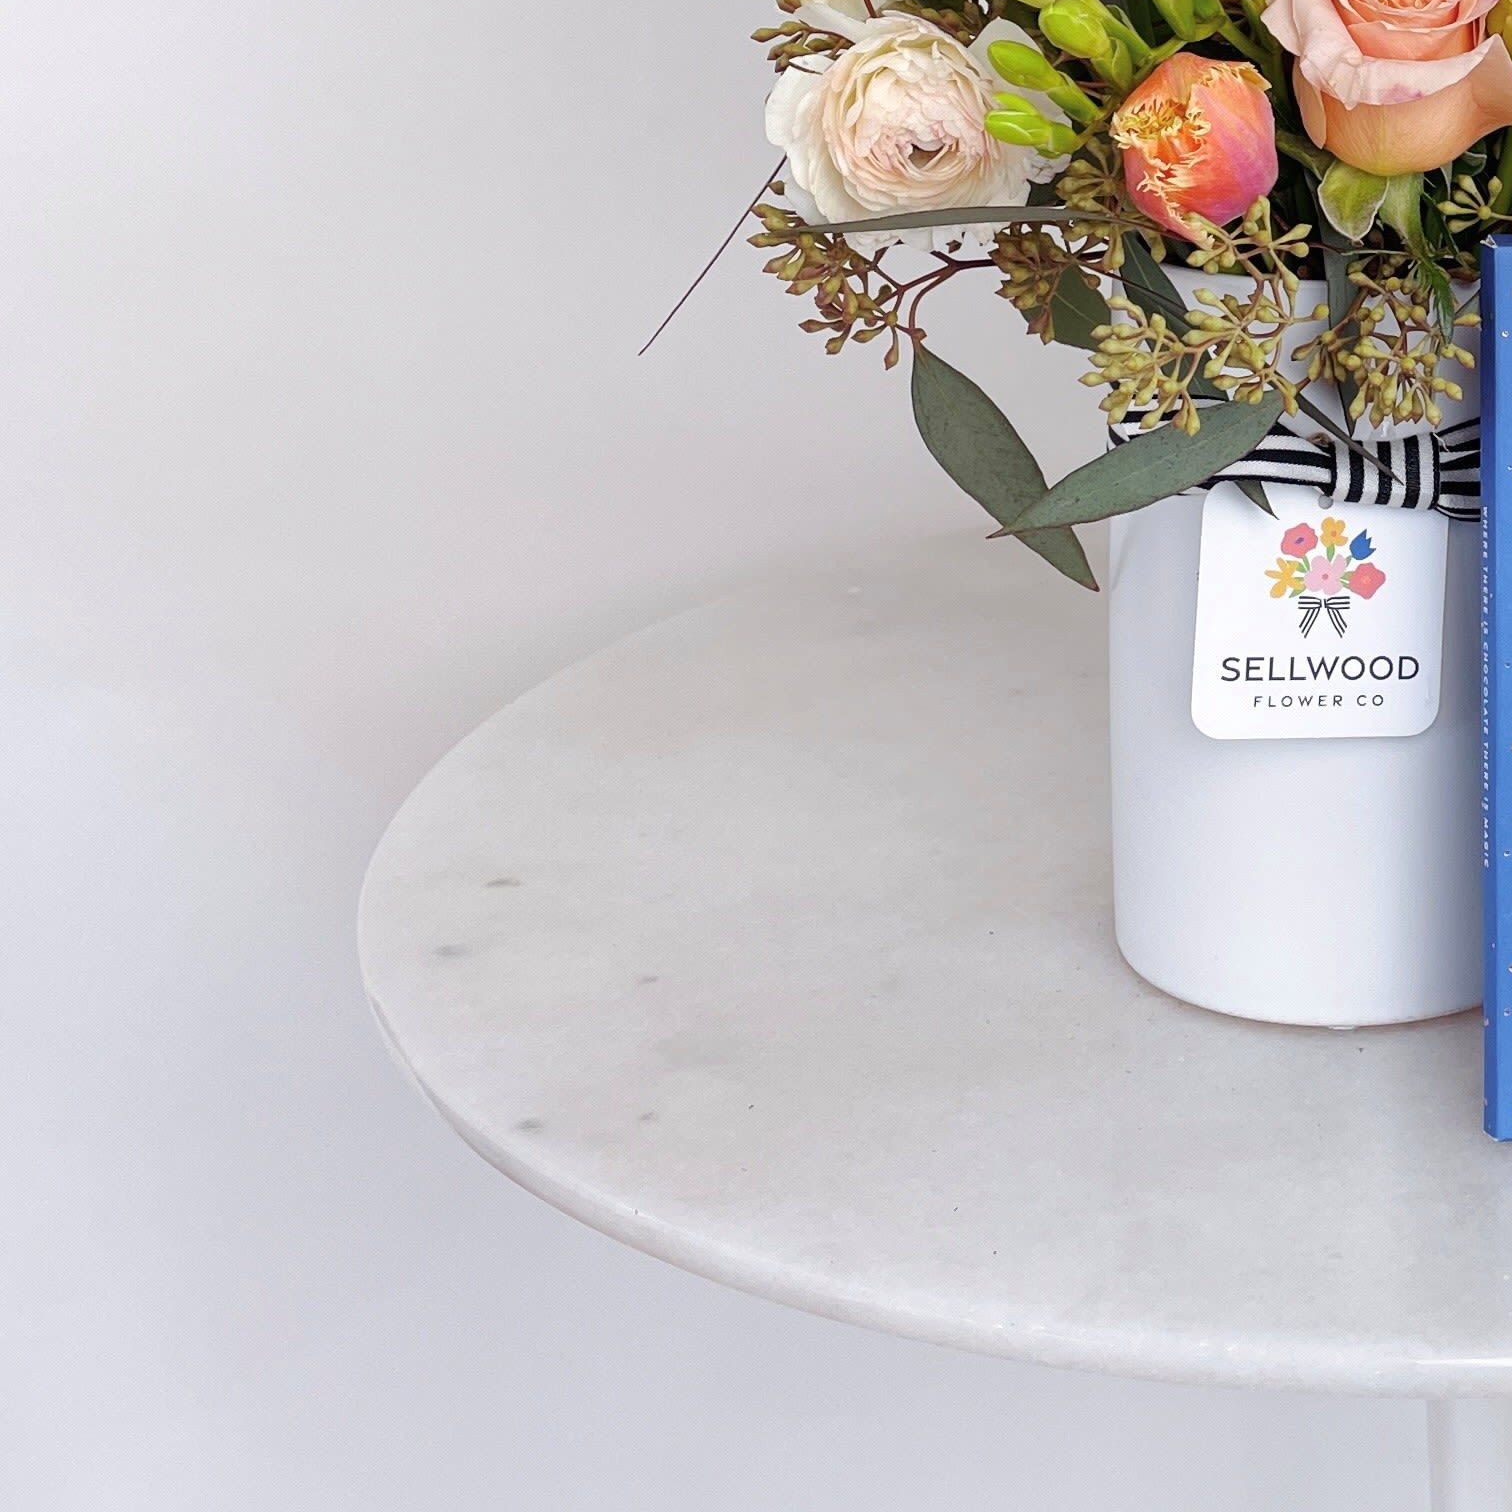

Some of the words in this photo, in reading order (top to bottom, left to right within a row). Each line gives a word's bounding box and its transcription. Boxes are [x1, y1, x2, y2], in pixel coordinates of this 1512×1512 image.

[1220, 655, 1420, 682] SELLWOOD
[1253, 695, 1343, 708] FLOWER
[1356, 694, 1385, 707] CO
